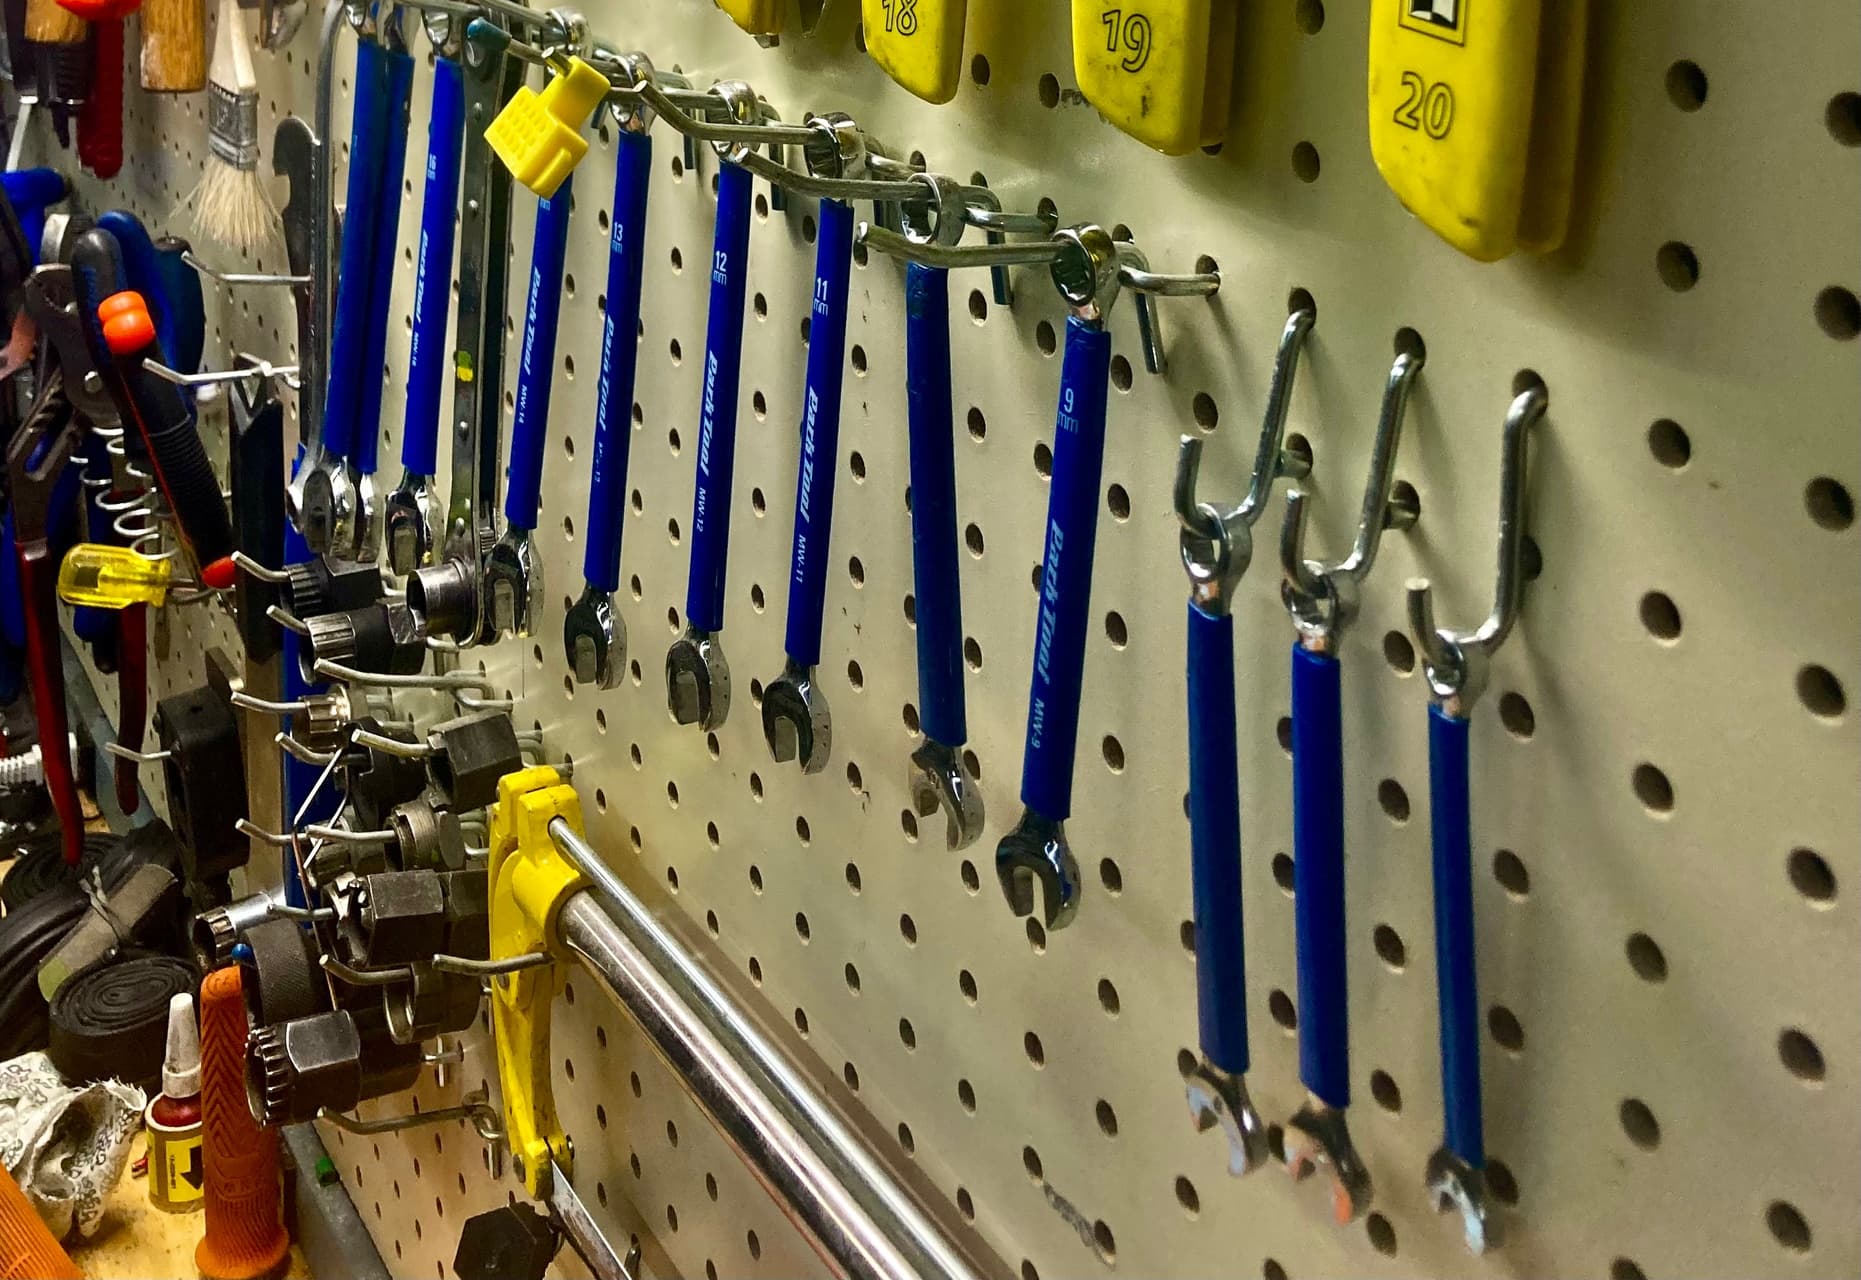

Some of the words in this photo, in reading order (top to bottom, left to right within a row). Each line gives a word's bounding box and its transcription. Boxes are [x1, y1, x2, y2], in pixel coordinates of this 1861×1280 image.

[1102, 9, 1152, 72] 19
[1393, 71, 1454, 140] 20
[614, 222, 623, 242] 13
[715, 251, 727, 271] 12
[816, 277, 828, 300] 11
[1063, 387, 1074, 414] 9
[1057, 410, 1078, 434] mm
[696, 487, 706, 532] MW-12
[797, 533, 806, 584] MW-11
[1031, 697, 1045, 750] MW-9
